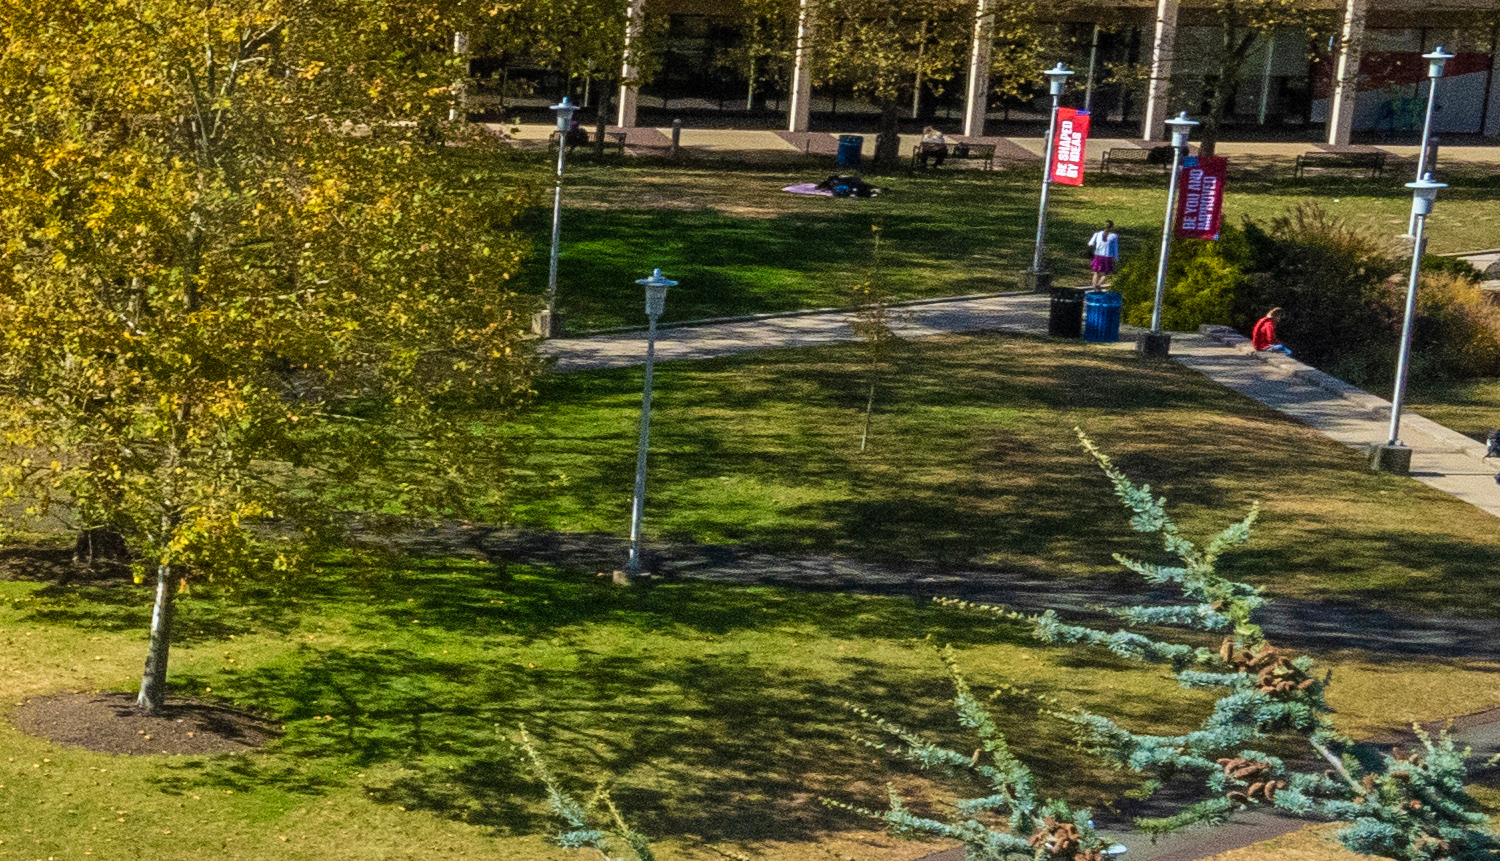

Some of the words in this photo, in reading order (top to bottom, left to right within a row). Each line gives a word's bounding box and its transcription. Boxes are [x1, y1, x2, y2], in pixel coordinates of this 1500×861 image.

[1058, 120, 1073, 161] SHAPED
[1069, 132, 1082, 162] IDEAS
[1066, 164, 1079, 178] BY
[1188, 169, 1204, 191] AND
[1184, 193, 1200, 214] YOU
[1182, 216, 1197, 230] BE
